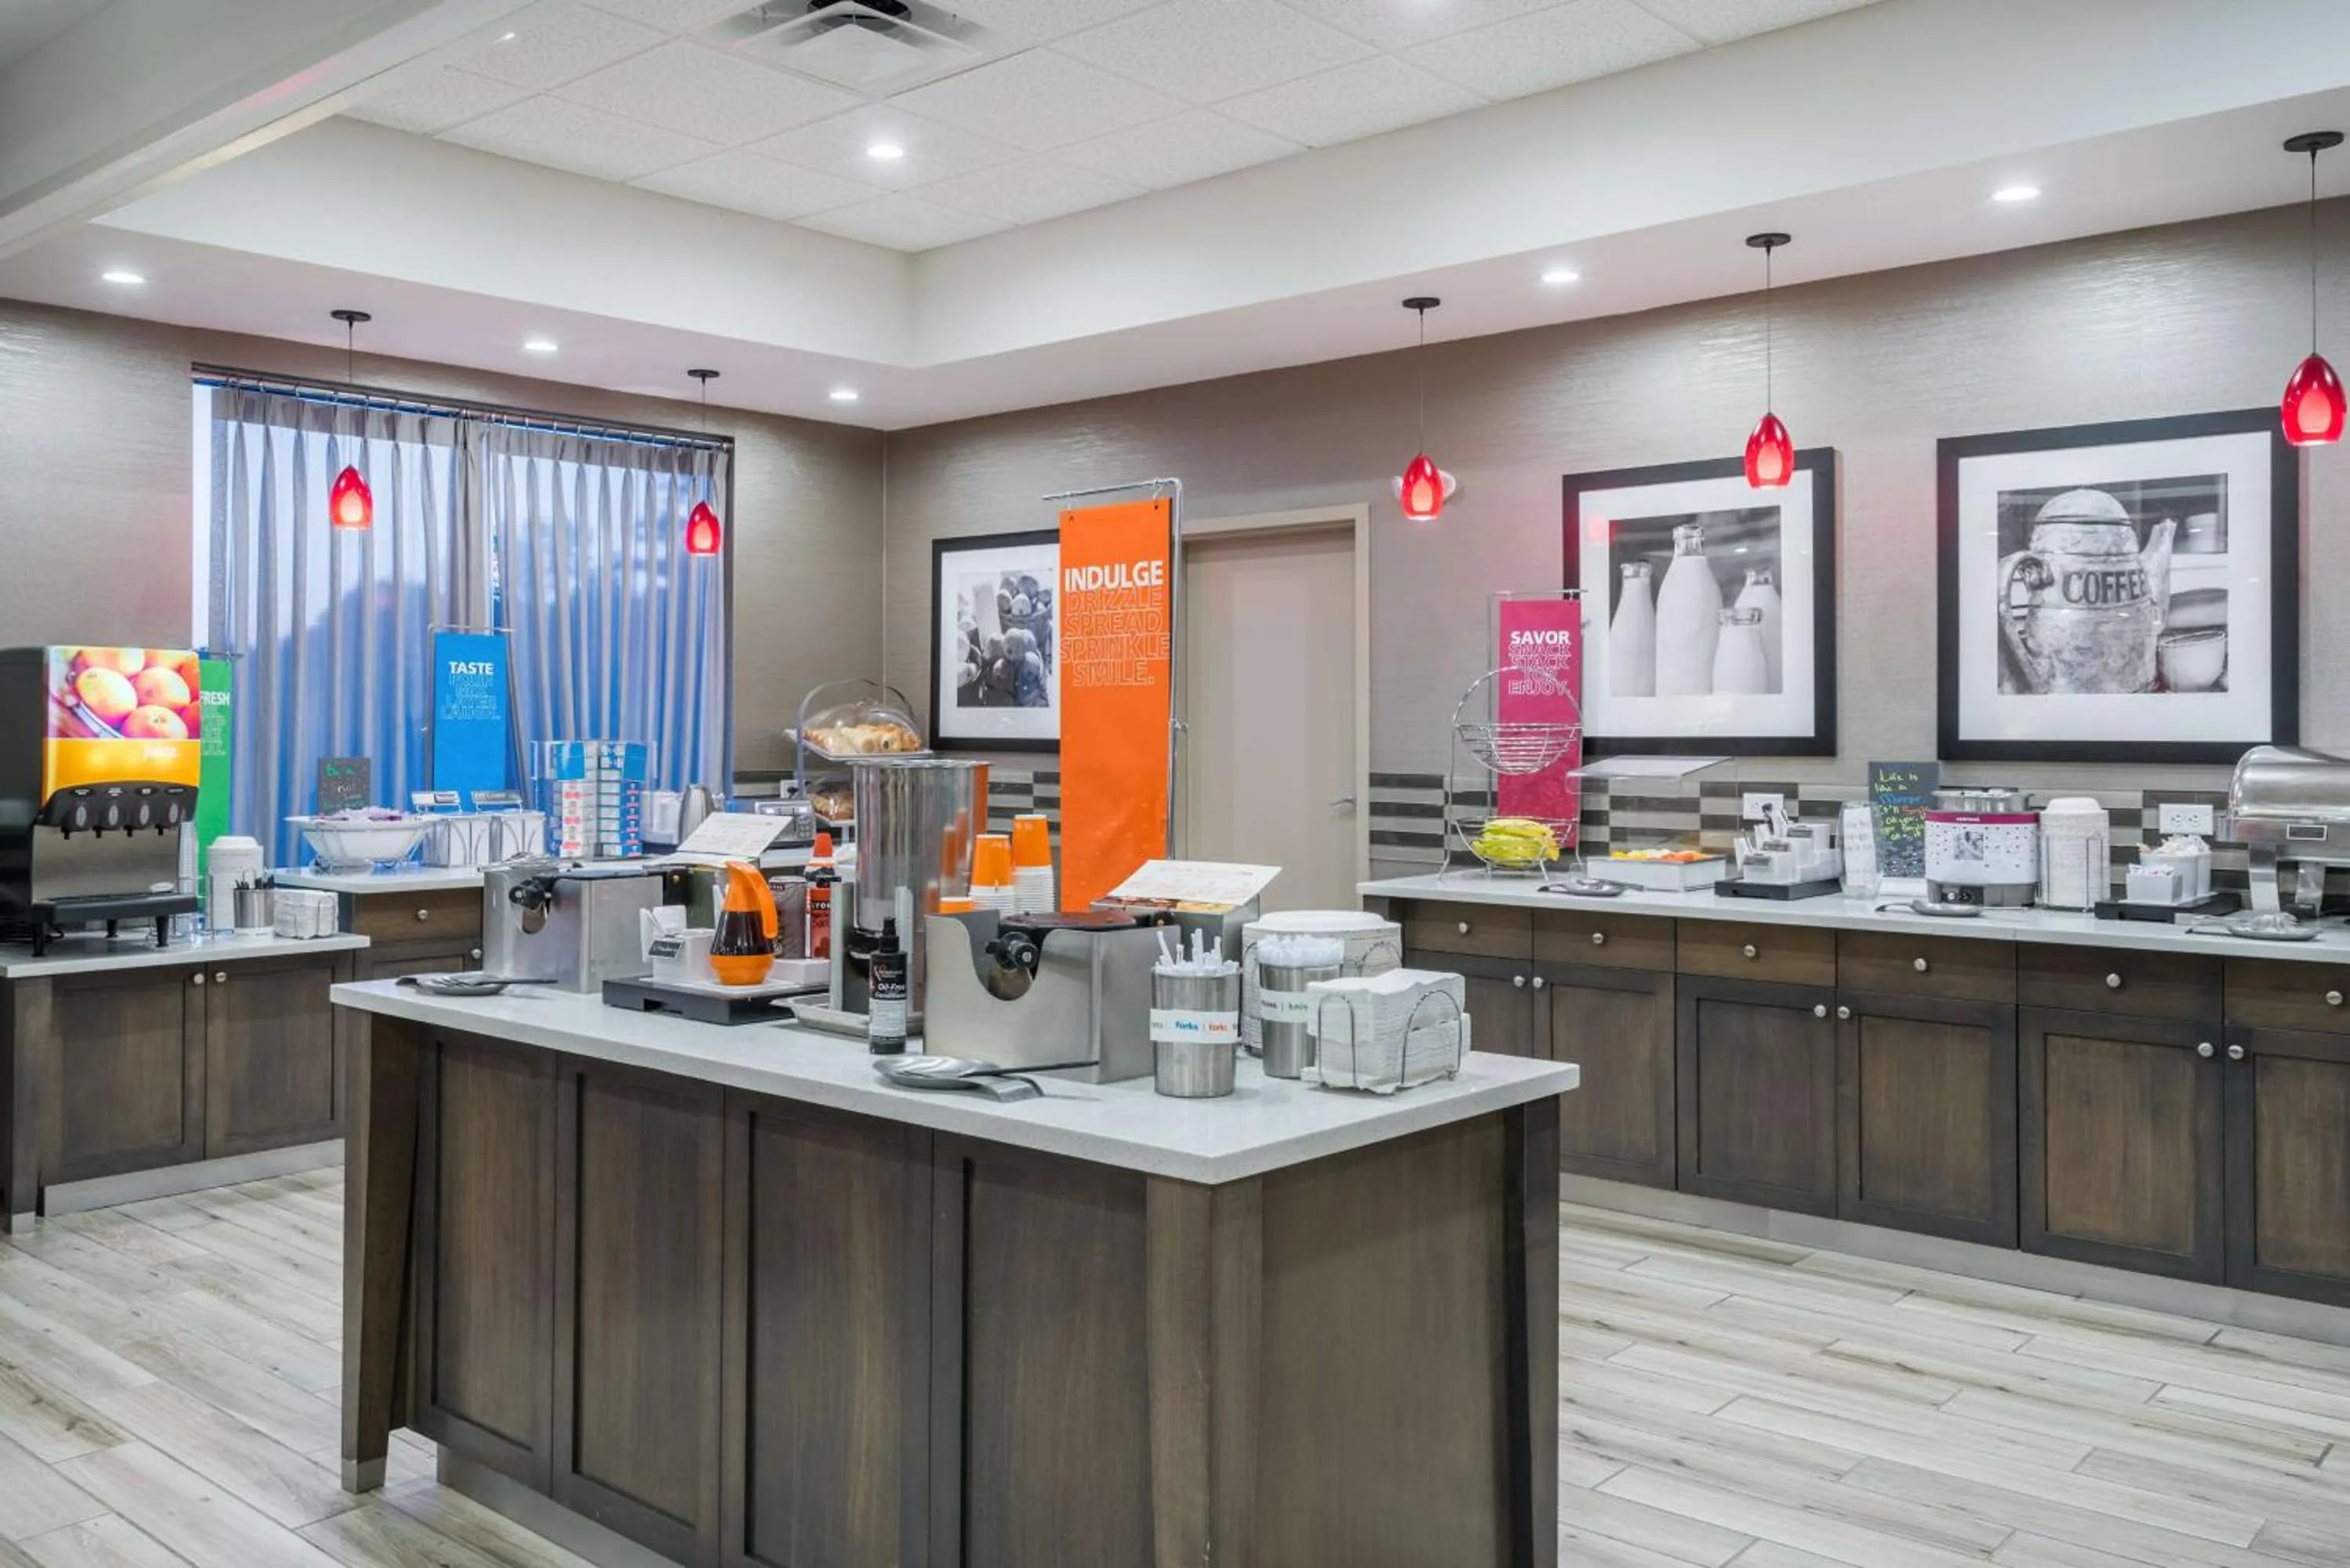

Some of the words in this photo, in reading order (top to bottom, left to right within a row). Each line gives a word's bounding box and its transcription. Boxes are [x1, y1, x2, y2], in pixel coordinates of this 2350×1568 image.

[1065, 560, 1164, 592] INDULGE
[2063, 569, 2147, 604] COFFEE
[1066, 587, 1163, 615] DRIZZLE
[1066, 609, 1164, 638] SPREAD
[1510, 630, 1570, 645] SAVOR
[1059, 632, 1171, 663] SPRINKLE
[1508, 641, 1571, 657] SNACK
[448, 661, 494, 675] TASTE
[1072, 659, 1155, 687] SMILE.
[1511, 654, 1570, 670] STACK
